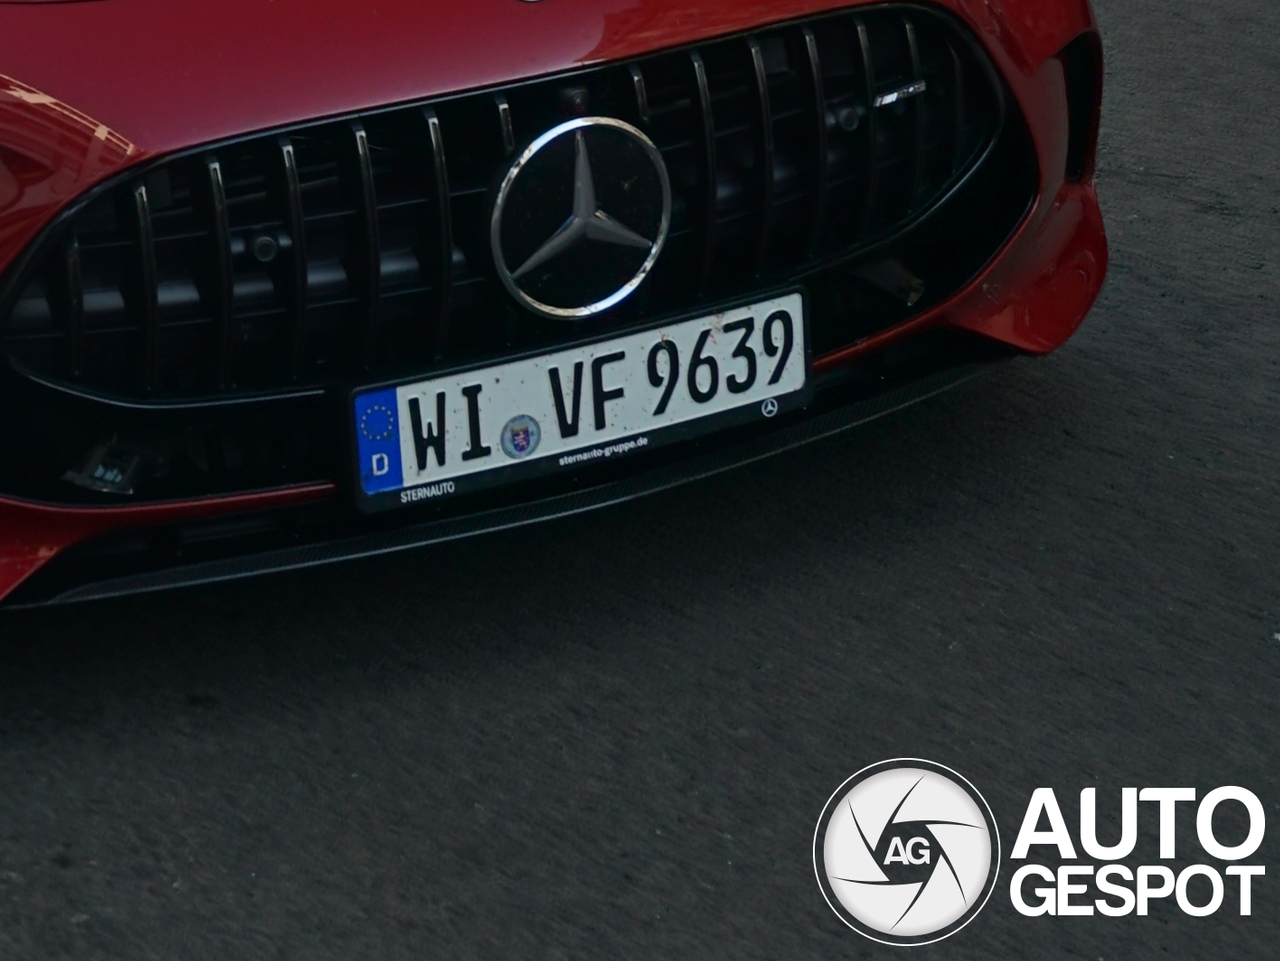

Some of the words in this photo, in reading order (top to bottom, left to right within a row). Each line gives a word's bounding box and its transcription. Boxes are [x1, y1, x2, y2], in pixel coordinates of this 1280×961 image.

[408, 384, 492, 471] WI
[548, 351, 626, 439] VF
[647, 309, 795, 417] 9639
[372, 452, 389, 476] D
[558, 436, 649, 466] sternauto-gruppe.de
[400, 481, 455, 503] STERNAUTO
